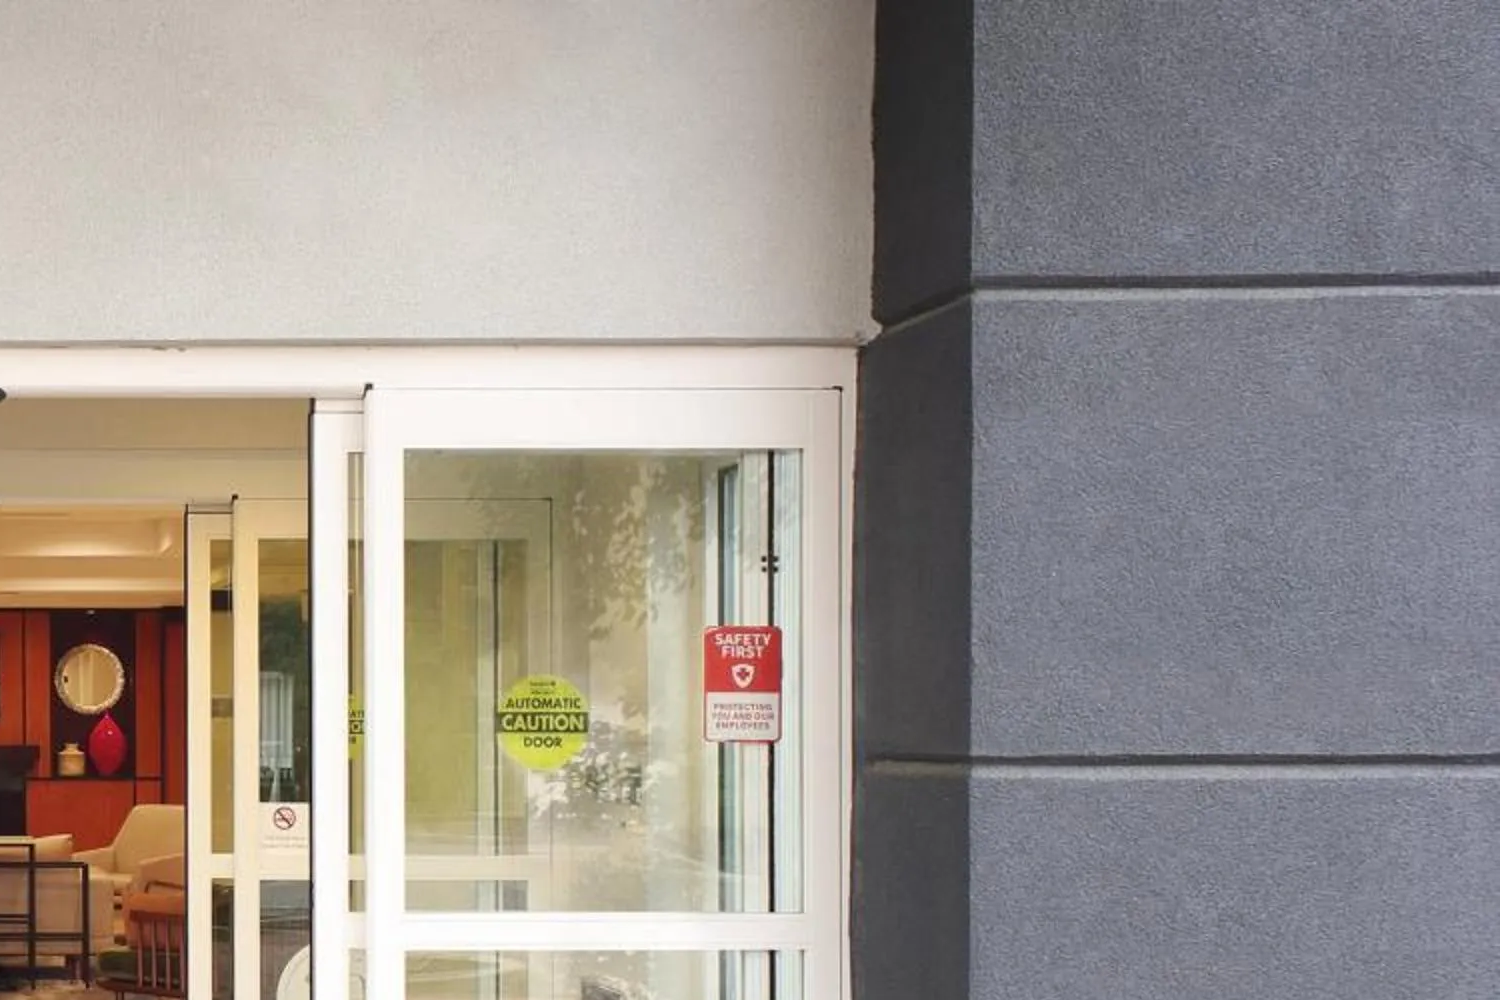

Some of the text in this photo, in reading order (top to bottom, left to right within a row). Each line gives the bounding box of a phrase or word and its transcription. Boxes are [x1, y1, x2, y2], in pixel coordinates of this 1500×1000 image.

[714, 633, 771, 645] SAFETY
[720, 645, 765, 659] FIRST
[506, 697, 581, 709] AUTOMATIC
[501, 713, 585, 732] CAUTION
[732, 712, 752, 721] AND
[524, 736, 563, 748] DOOR
